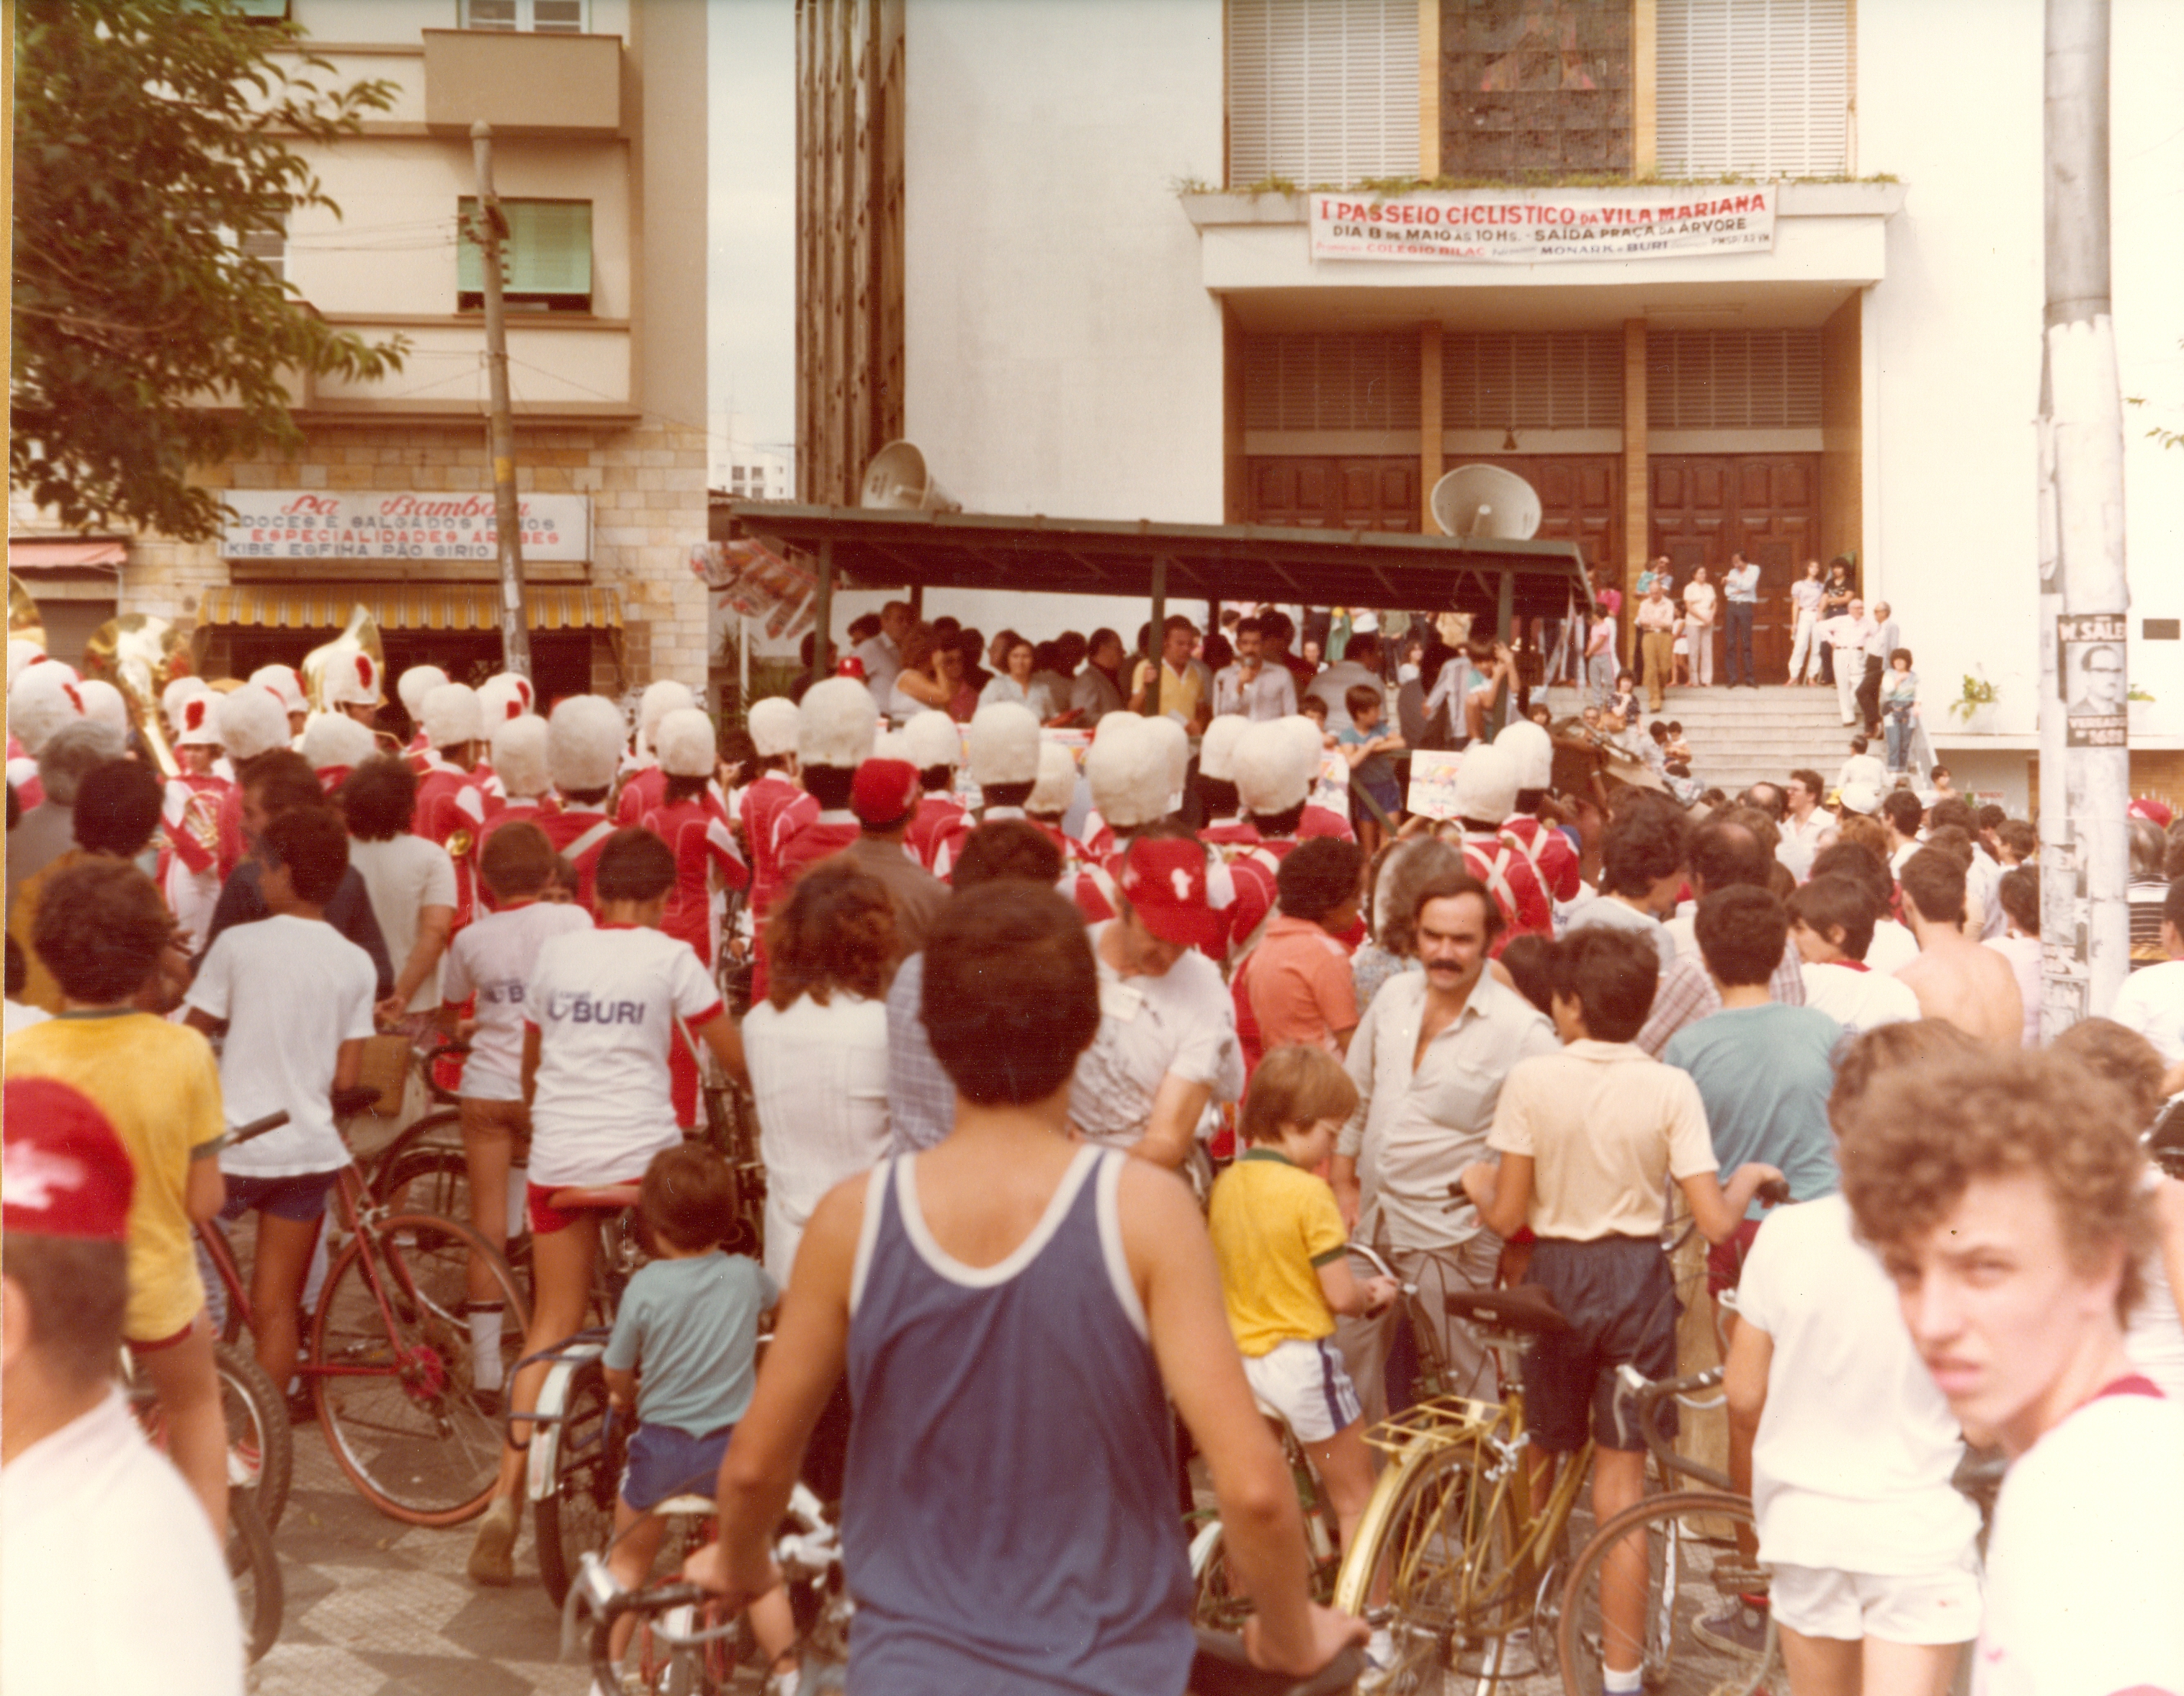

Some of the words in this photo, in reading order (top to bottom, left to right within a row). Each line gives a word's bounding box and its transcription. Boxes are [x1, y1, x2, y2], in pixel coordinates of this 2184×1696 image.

[1320, 200, 1330, 220] I
[1337, 202, 1441, 225] PASSEIO
[1446, 205, 1575, 225] CICLISTICO
[1580, 213, 1598, 225] DA
[1601, 207, 1653, 225] VILA
[1657, 193, 1766, 222] MARIANA
[1333, 225, 1362, 238] DIA
[1369, 228, 1382, 239] 8
[1386, 231, 1401, 241] DE
[1406, 229, 1451, 241] MAIO
[1535, 227, 1595, 242] SAÍDA
[1600, 225, 1655, 239] PRAÇA
[1659, 225, 1674, 235] DA
[1678, 218, 1747, 233] ÁRVORE
[1439, 246, 1485, 256] BILAC
[1541, 243, 1614, 256] MONARK
[1626, 241, 1668, 252] BURI
[280, 494, 339, 516] La
[242, 515, 315, 529] DOCES
[326, 515, 339, 529] E
[352, 516, 472, 530] SALGADOS
[485, 518, 555, 530] FOS
[251, 528, 458, 544] ESPECIALIDADES
[228, 543, 274, 556] KIBE
[290, 543, 368, 557] ESFIHA
[572, 1000, 647, 1025] BURI
